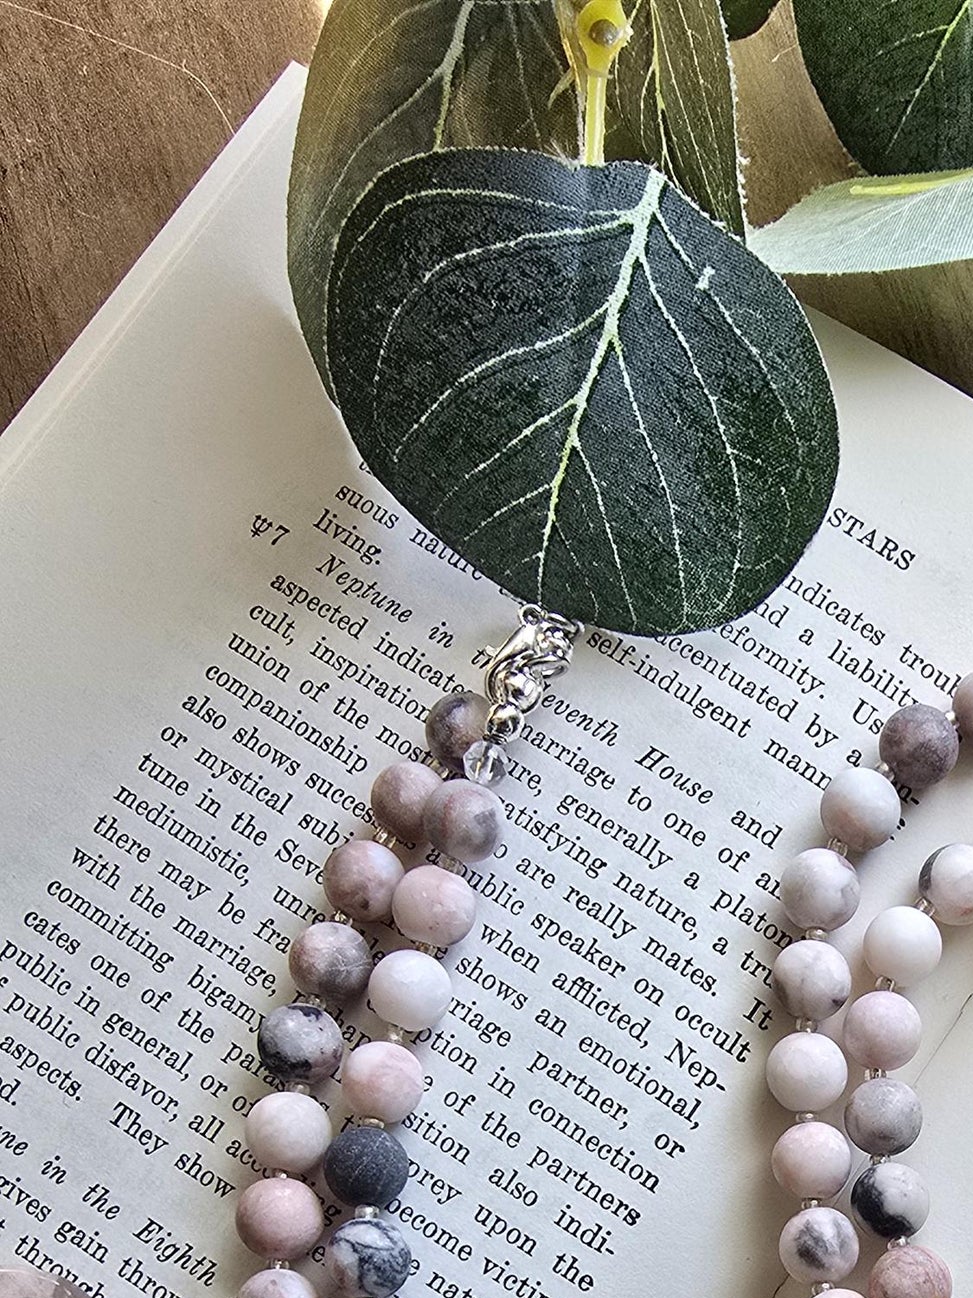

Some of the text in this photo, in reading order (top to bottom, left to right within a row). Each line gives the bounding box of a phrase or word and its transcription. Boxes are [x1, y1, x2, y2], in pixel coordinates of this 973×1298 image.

[312, 507, 383, 566] living.
[334, 485, 752, 740] suous self-indulgent
[826, 507, 917, 571] STARS
[227, 632, 698, 941] union the nature,
[249, 605, 674, 871] cult, generally
[269, 574, 707, 848] aspected one
[314, 552, 784, 850] Neptune House and
[650, 622, 840, 749] accentuated by
[112, 783, 629, 1131] mediumistic, partner,
[137, 752, 702, 1131] tune the shows emotional,
[181, 695, 752, 1063] also shows speaker occult
[193, 746, 726, 1092] mystical when afflicted, Nep-
[205, 665, 772, 1031] companionship are really mates. It
[23, 911, 594, 1292] cates one the upon the
[46, 880, 615, 1256] committing also indi-
[71, 846, 642, 1227] with the marriage, the partners
[84, 1040, 180, 1123] disfavor,
[187, 1114, 226, 1144] all
[93, 814, 660, 1195] there may connection
[101, 1007, 194, 1082] general,
[53, 1221, 109, 1265] gain
[81, 1183, 218, 1288] the Eighth
[108, 1101, 170, 1156] They
[174, 1153, 236, 1200] show
